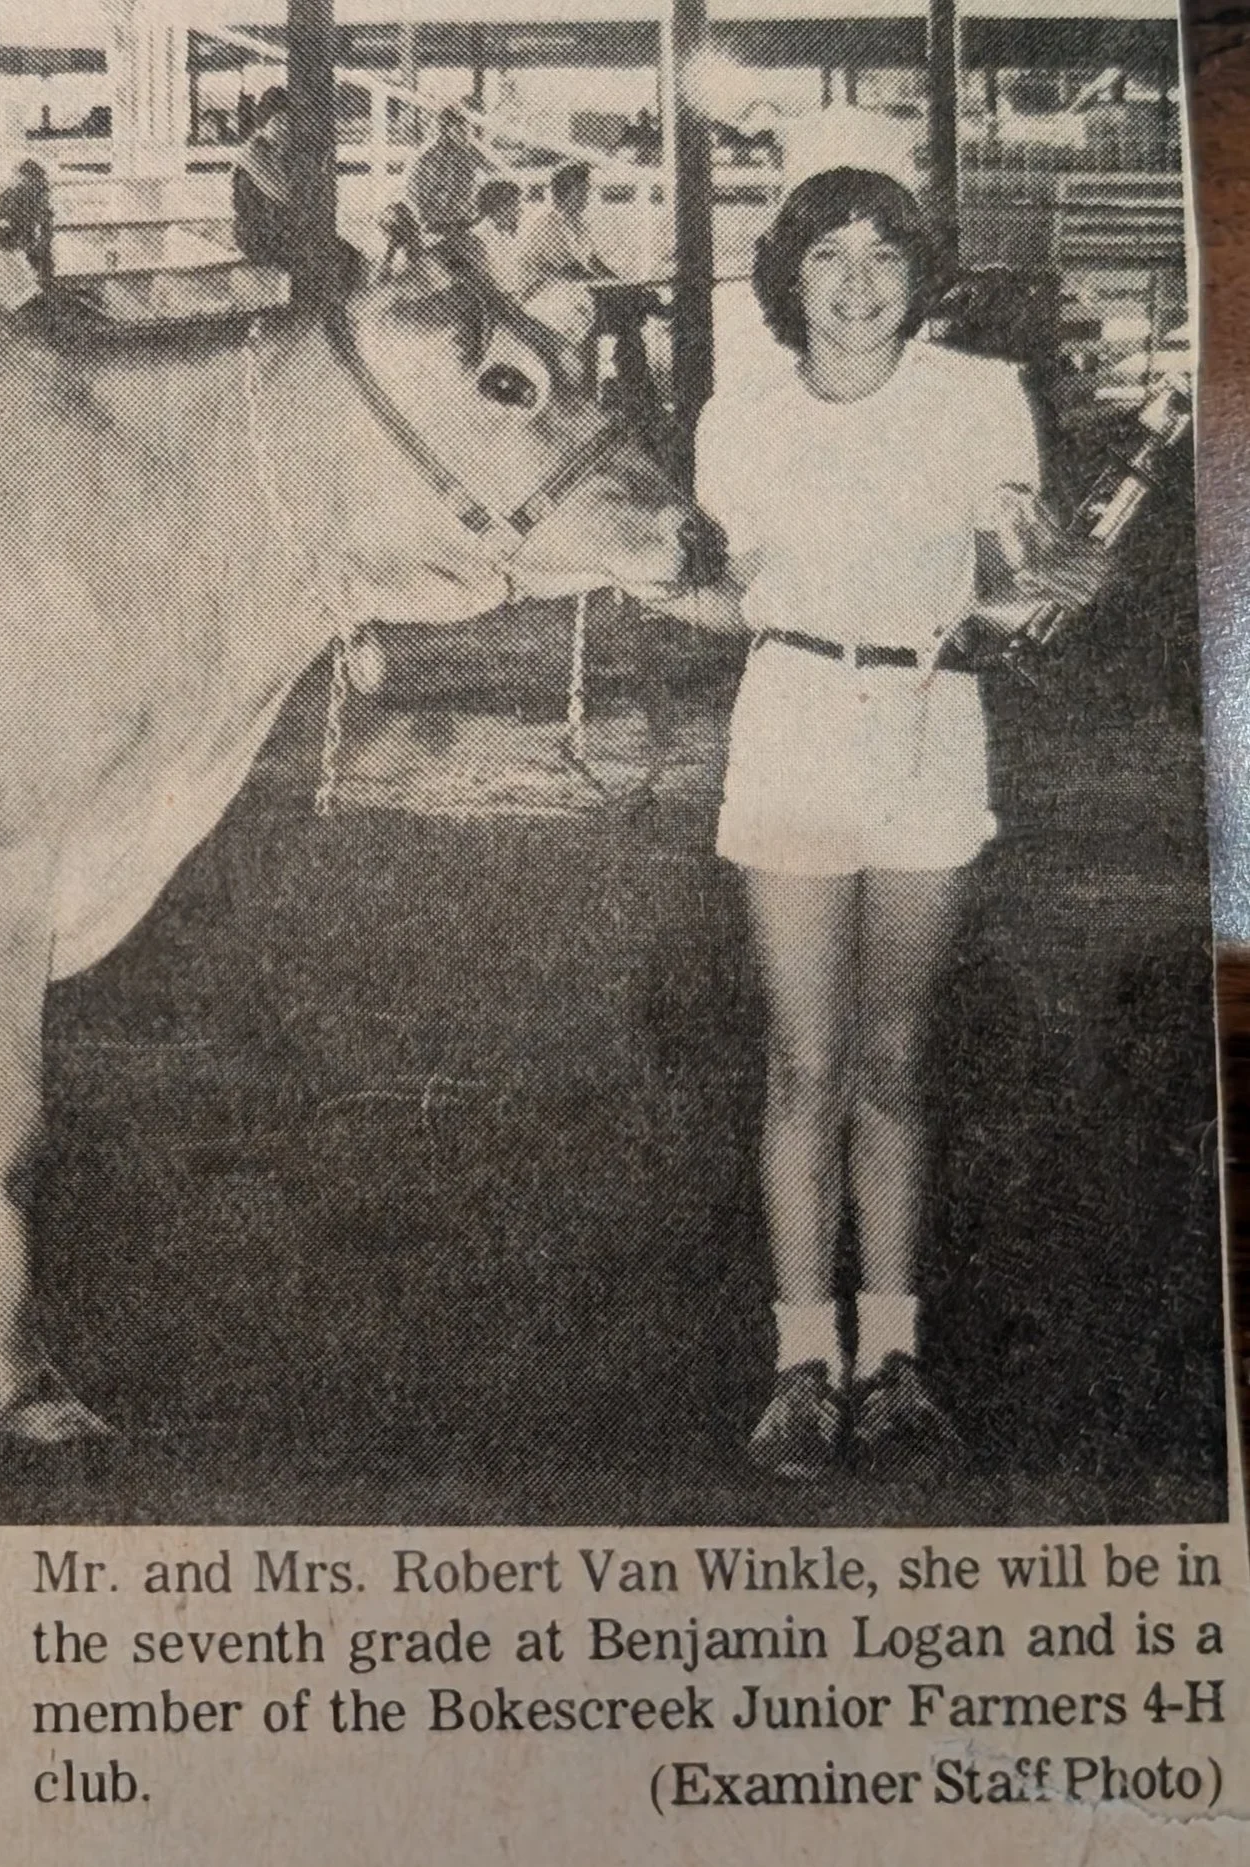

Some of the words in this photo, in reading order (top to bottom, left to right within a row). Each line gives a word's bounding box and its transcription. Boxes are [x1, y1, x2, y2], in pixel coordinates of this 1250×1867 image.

[33, 1550, 118, 1594] Mr.
[143, 1549, 232, 1594] and
[254, 1550, 365, 1594] Mrs.
[393, 1548, 562, 1594] Robert
[578, 1549, 679, 1593] Van
[695, 1546, 878, 1599] Winkle,
[898, 1545, 980, 1592] she
[997, 1544, 1087, 1589] will
[1104, 1543, 1160, 1588] be
[1177, 1542, 1222, 1588] in
[32, 1619, 108, 1665] the
[132, 1619, 325, 1664] seventh
[348, 1618, 491, 1675] grade
[515, 1619, 565, 1663] at
[587, 1614, 829, 1673] Benjamin
[852, 1615, 1006, 1670] Logan
[1027, 1611, 1116, 1658] and
[1136, 1610, 1176, 1656] is
[1196, 1622, 1224, 1655] a
[32, 1688, 244, 1734] member
[263, 1687, 311, 1734] of
[329, 1688, 406, 1734] the
[428, 1684, 715, 1733] Bokescreek
[732, 1684, 892, 1731] Junior
[907, 1683, 1128, 1728] Farmers
[1143, 1679, 1226, 1724] 4-H
[34, 1758, 150, 1804] club.
[650, 1759, 923, 1817] (Examiner
[1063, 1755, 1223, 1809] Photo)
